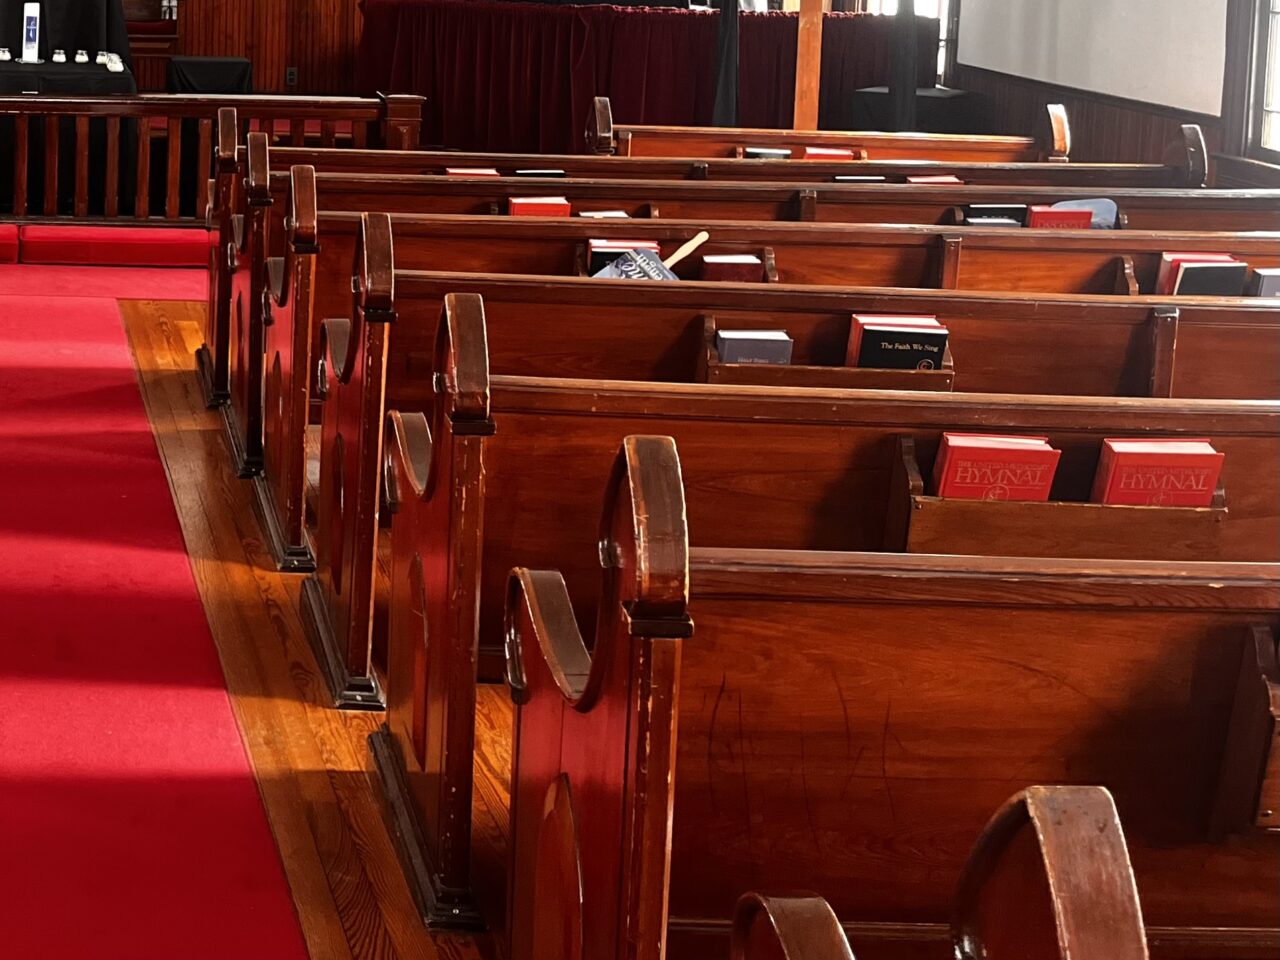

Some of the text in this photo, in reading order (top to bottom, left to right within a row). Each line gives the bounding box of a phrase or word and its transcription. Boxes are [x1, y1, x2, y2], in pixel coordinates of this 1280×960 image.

[923, 344, 939, 352] Sing
[954, 467, 1047, 486] HYMNAL
[1119, 473, 1209, 490] HYMNAL
